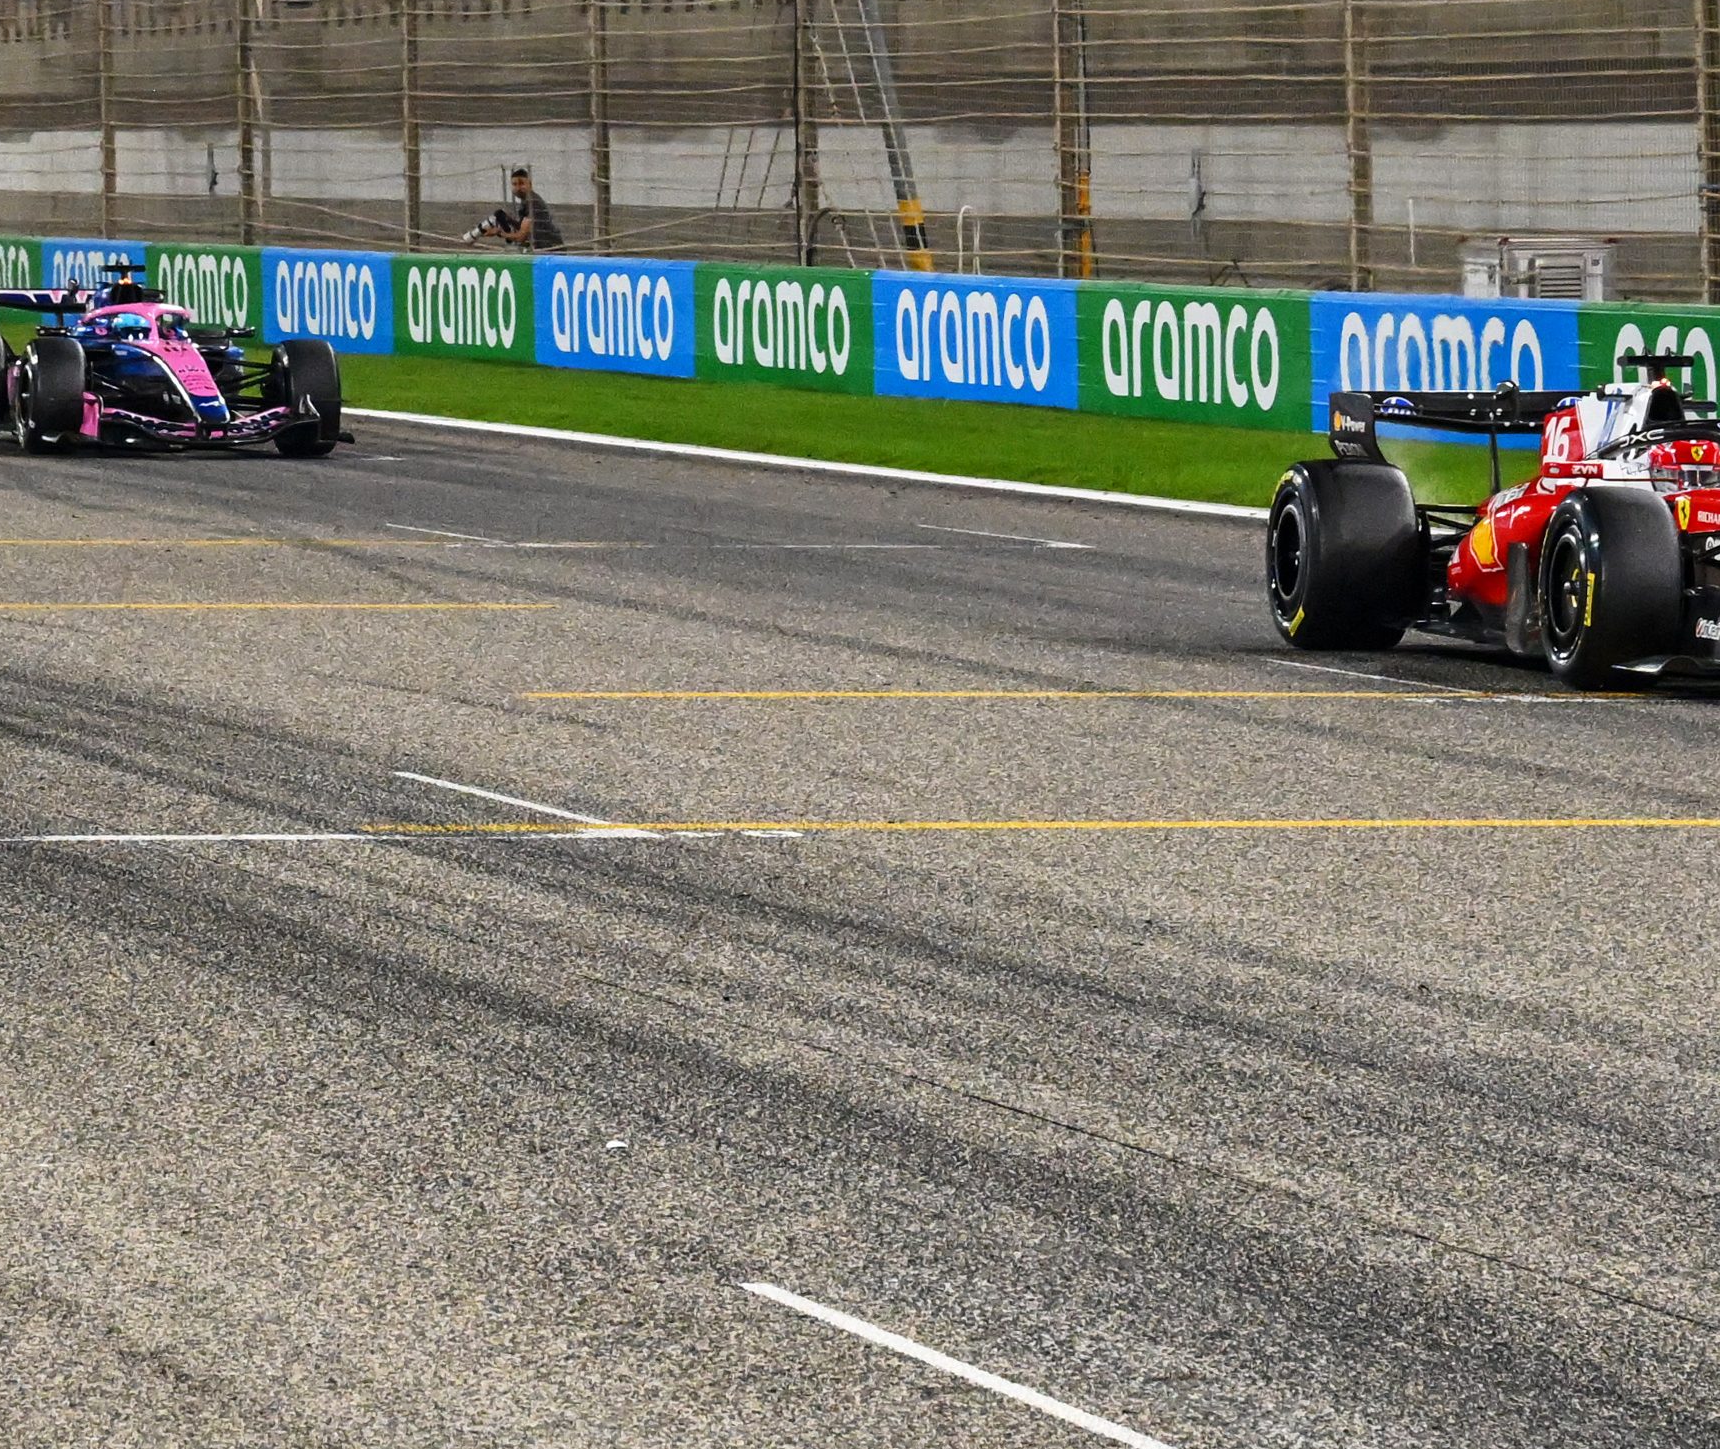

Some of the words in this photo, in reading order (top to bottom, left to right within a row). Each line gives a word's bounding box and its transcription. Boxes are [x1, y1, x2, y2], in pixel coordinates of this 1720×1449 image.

[54, 251, 131, 290] aram
[158, 253, 248, 327] aramco
[276, 260, 376, 339] aramco
[407, 266, 516, 349] aramco
[552, 271, 673, 360] aramco
[714, 278, 850, 375] aramco
[896, 289, 1050, 391] aramco
[1103, 299, 1279, 410] aramco
[1340, 312, 1543, 391] aramco
[1543, 416, 1571, 463] 16
